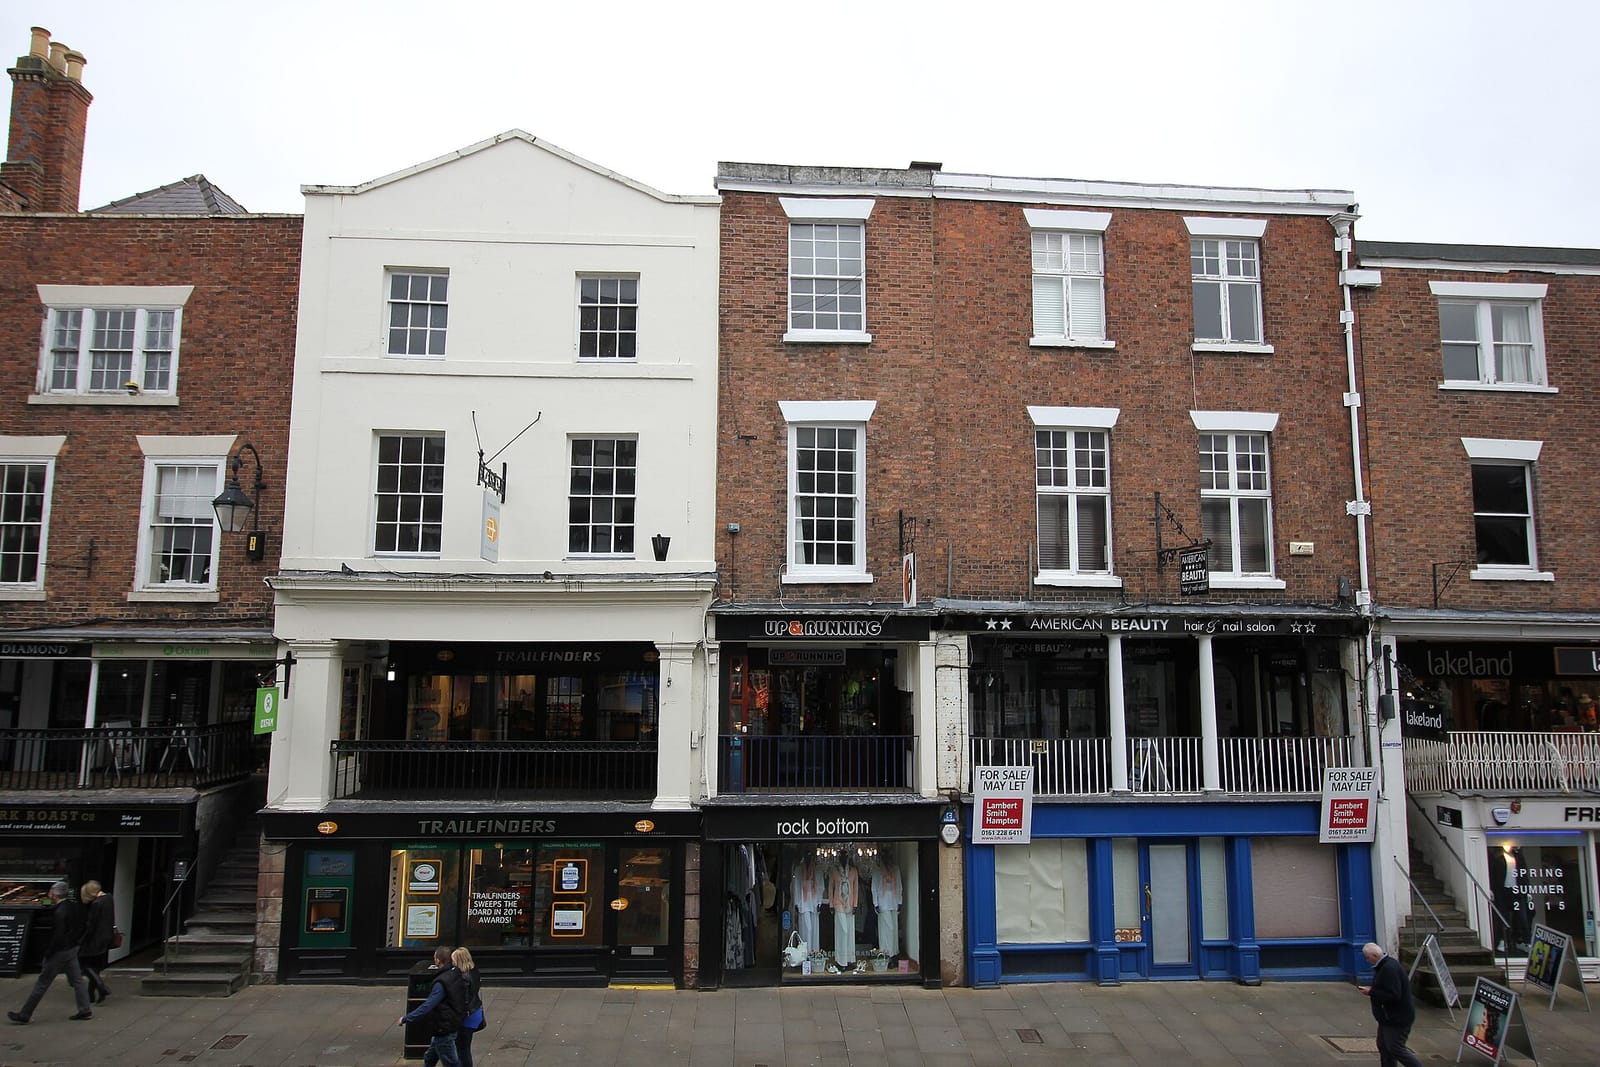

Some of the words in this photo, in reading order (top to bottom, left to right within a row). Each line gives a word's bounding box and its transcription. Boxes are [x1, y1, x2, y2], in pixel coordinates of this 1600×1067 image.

[1182, 553, 1206, 564] AMERICAN
[1182, 569, 1206, 581] BEAUTY
[1030, 617, 1103, 630] AMERICAN
[1111, 618, 1170, 631] BEAUTY
[1184, 620, 1204, 631] hair
[1206, 618, 1220, 634] &
[1222, 620, 1243, 632] nail
[1246, 620, 1276, 632] salon
[2, 645, 69, 655] DIAMOND
[496, 650, 601, 662] TRAILFINDERS
[1427, 650, 1513, 676] lakeland
[1406, 710, 1442, 729] lakeland
[980, 770, 1000, 780] FOR
[1003, 770, 1030, 780] SALE/
[1328, 771, 1347, 781] FOR
[1350, 771, 1376, 782] SALE/
[983, 781, 1006, 791] MAY
[1009, 781, 1026, 791] LET
[1331, 781, 1354, 791] MAY
[1356, 781, 1372, 791] LET
[0, 811, 19, 821] RK
[26, 811, 79, 821] ROAST
[986, 809, 1008, 817] Smith
[1333, 809, 1354, 817] Smith
[986, 817, 1019, 826] Hampton
[1333, 817, 1364, 825] Hampton
[418, 819, 557, 834] TRAILFINDERS
[777, 818, 810, 835] rock
[816, 818, 869, 834] bottom
[1511, 868, 1564, 877] SPRING
[1511, 884, 1564, 894] SUMMER
[472, 892, 521, 900] TRAILFINDERS
[474, 900, 502, 908] SWEEPS
[504, 900, 518, 908] THE
[468, 908, 493, 916] BOARD
[493, 908, 502, 916] IN
[503, 908, 523, 916] 2014
[478, 916, 512, 924] AWARDS!
[1536, 928, 1566, 948] SUNBED
[1491, 995, 1509, 1007] BEAUTY
